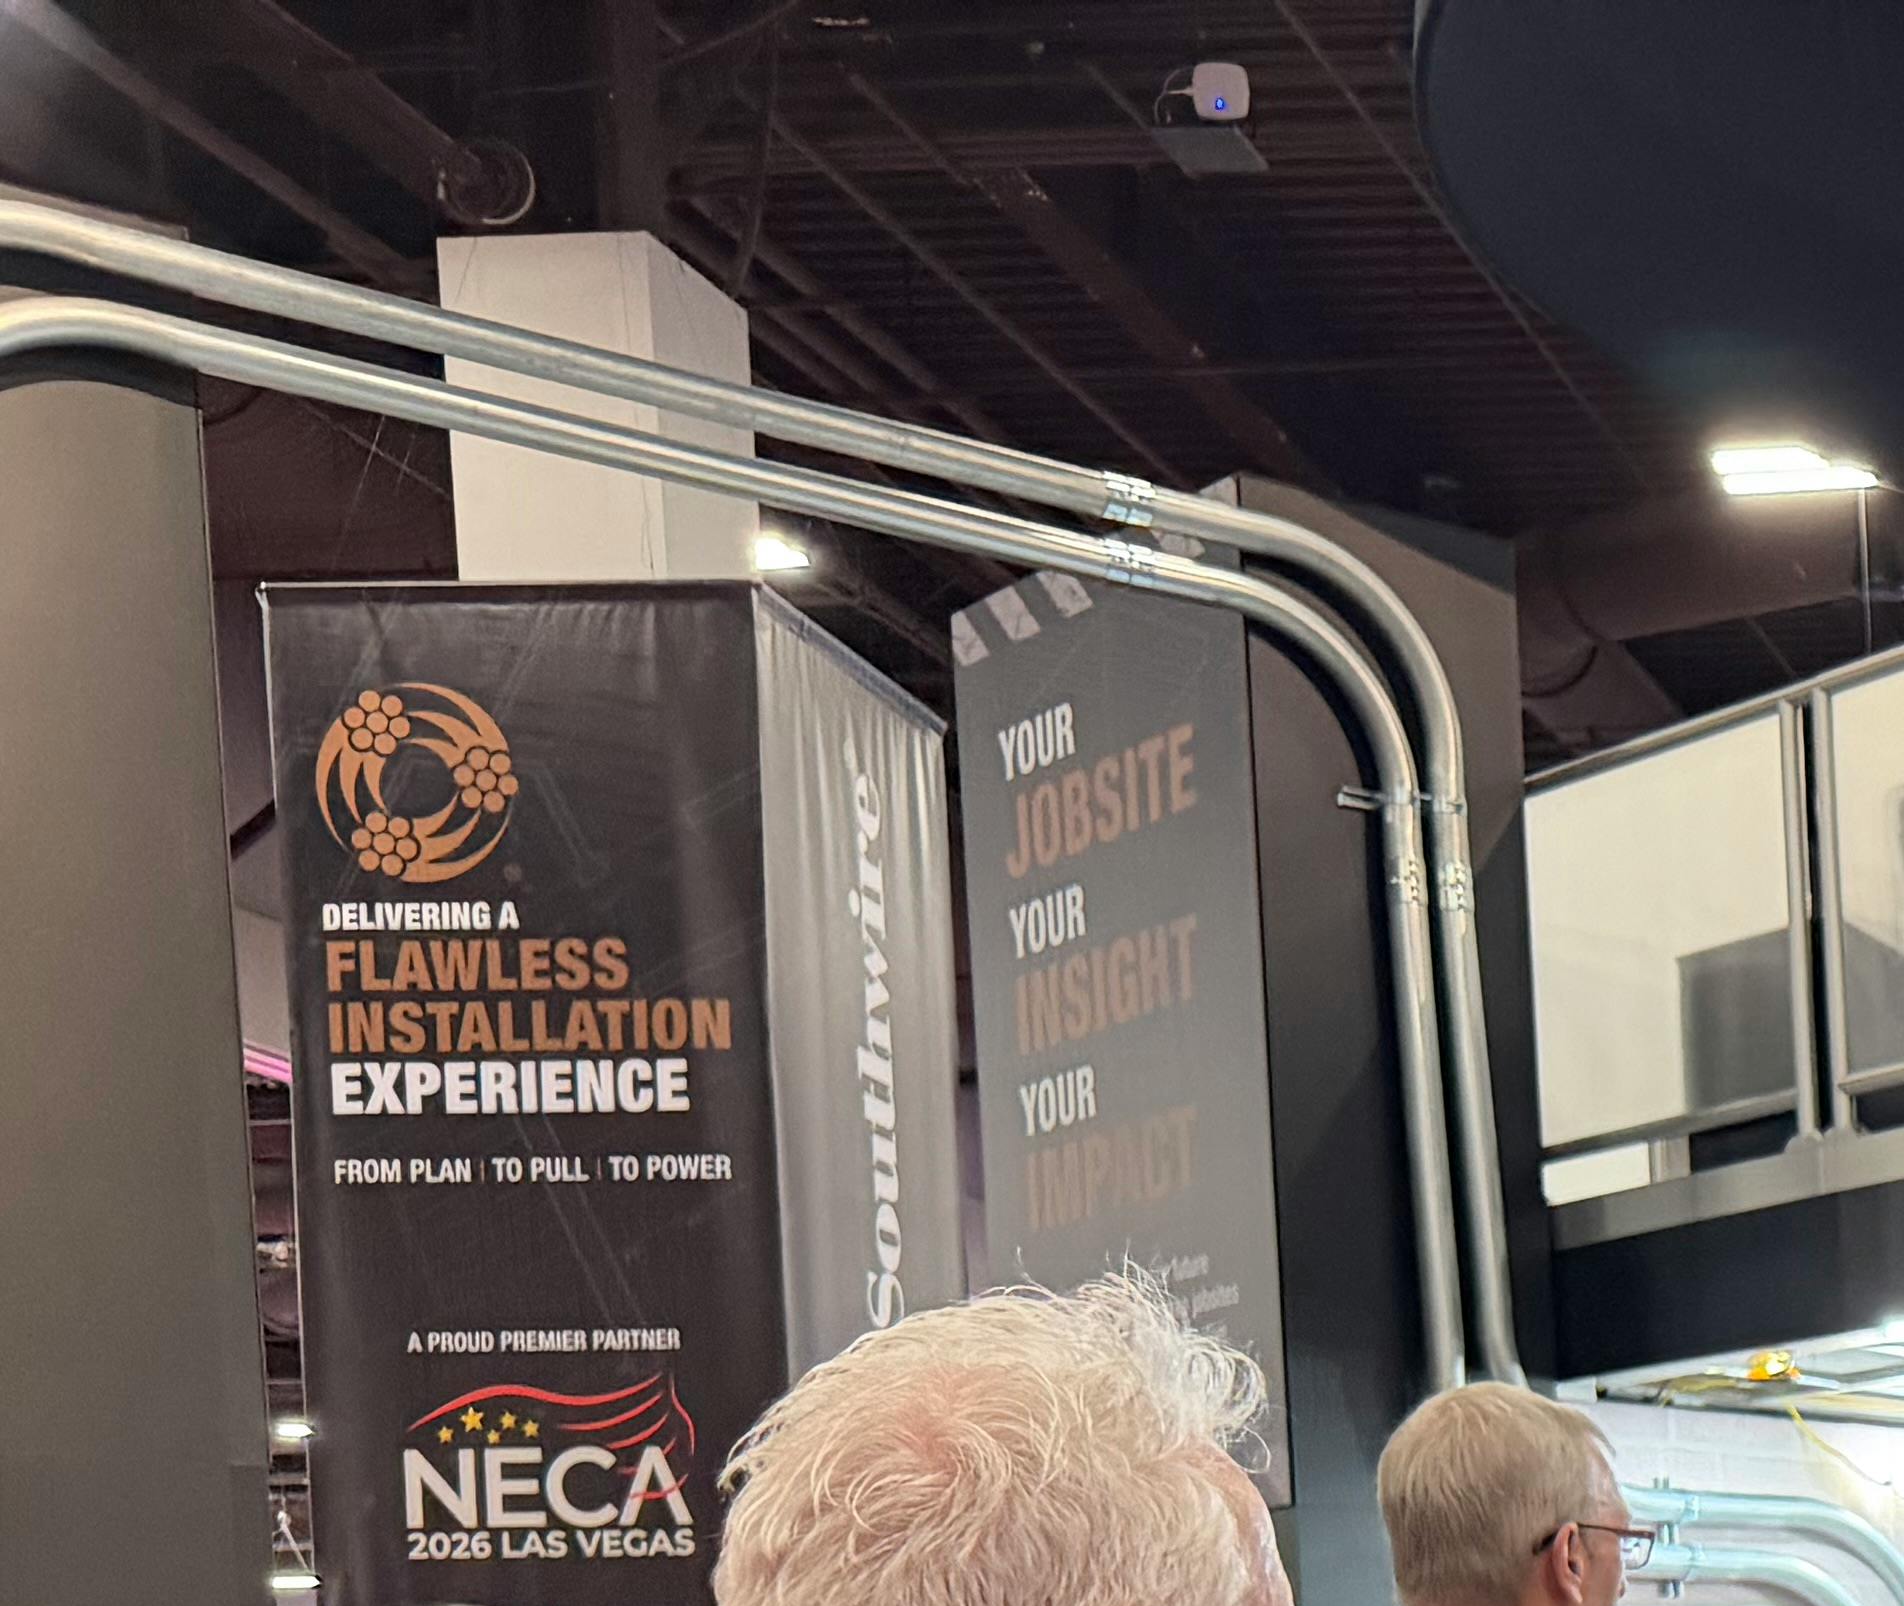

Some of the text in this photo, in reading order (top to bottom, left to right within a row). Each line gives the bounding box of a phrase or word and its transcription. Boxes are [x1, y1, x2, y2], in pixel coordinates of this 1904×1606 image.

[998, 702, 1076, 782] YOUR
[1006, 722, 1198, 879] JOBSITE
[322, 901, 521, 932] DELIVERING A
[1009, 883, 1087, 959] YOUR
[326, 937, 631, 993] FLAWLESS
[1014, 913, 1198, 1057] INSIGHT
[328, 997, 732, 1054] INSTALLATION
[330, 1057, 691, 1116] EXPERIENCE
[1019, 1064, 1097, 1137] YOUR
[334, 1154, 732, 1185] FROM PLAN TO PULL TO POWER
[407, 1328, 681, 1353] A PROUD PREMIER PARTNER
[402, 1445, 694, 1529] NECA
[407, 1527, 696, 1560] 2026 LAS VEGAS
